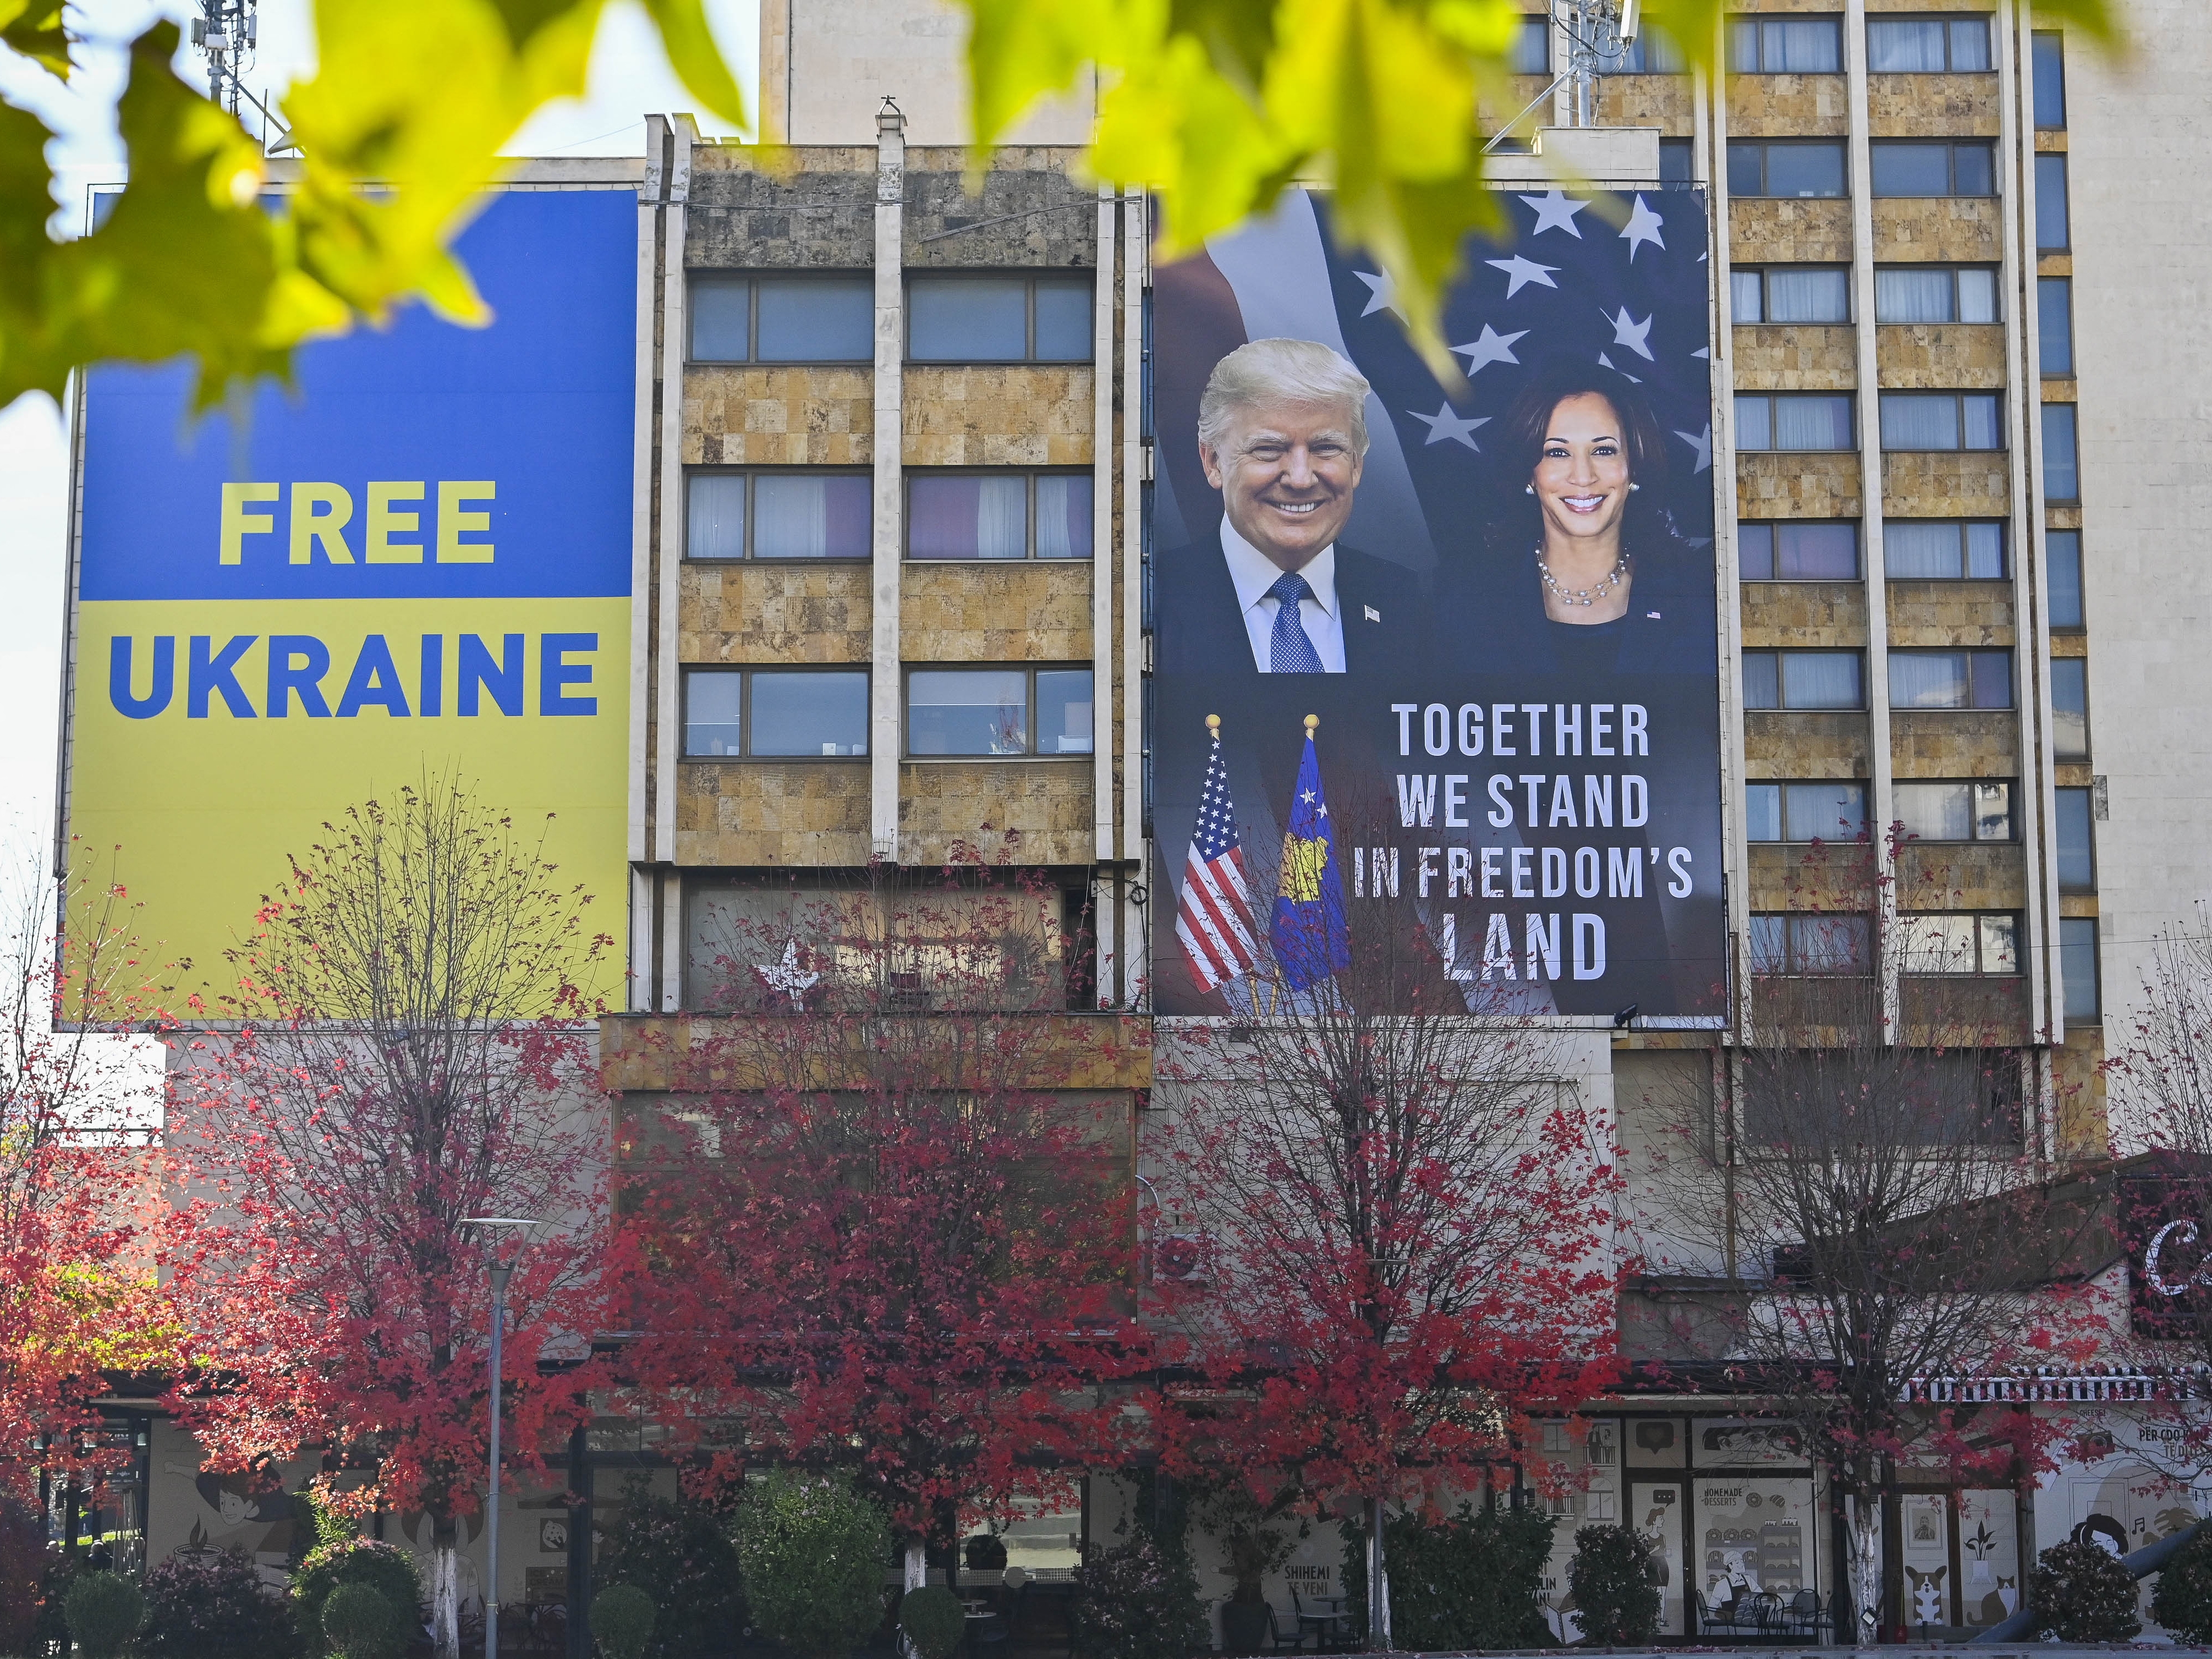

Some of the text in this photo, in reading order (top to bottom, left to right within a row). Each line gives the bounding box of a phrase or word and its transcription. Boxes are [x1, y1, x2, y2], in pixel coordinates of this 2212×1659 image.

[219, 481, 496, 565] FREE
[109, 633, 598, 719] UKRAINE
[1391, 704, 1649, 756] TOGETHER
[1396, 774, 1649, 827] WE STAND
[1354, 847, 1693, 898] IN FREEDOM'S
[1442, 913, 1606, 980] LAND
[1704, 1488, 1742, 1497] HOMEMADE
[1704, 1497, 1737, 1506] DESSERTS
[1285, 1565, 1330, 1580] SHIHEMI
[1302, 1581, 1328, 1595] VENI
